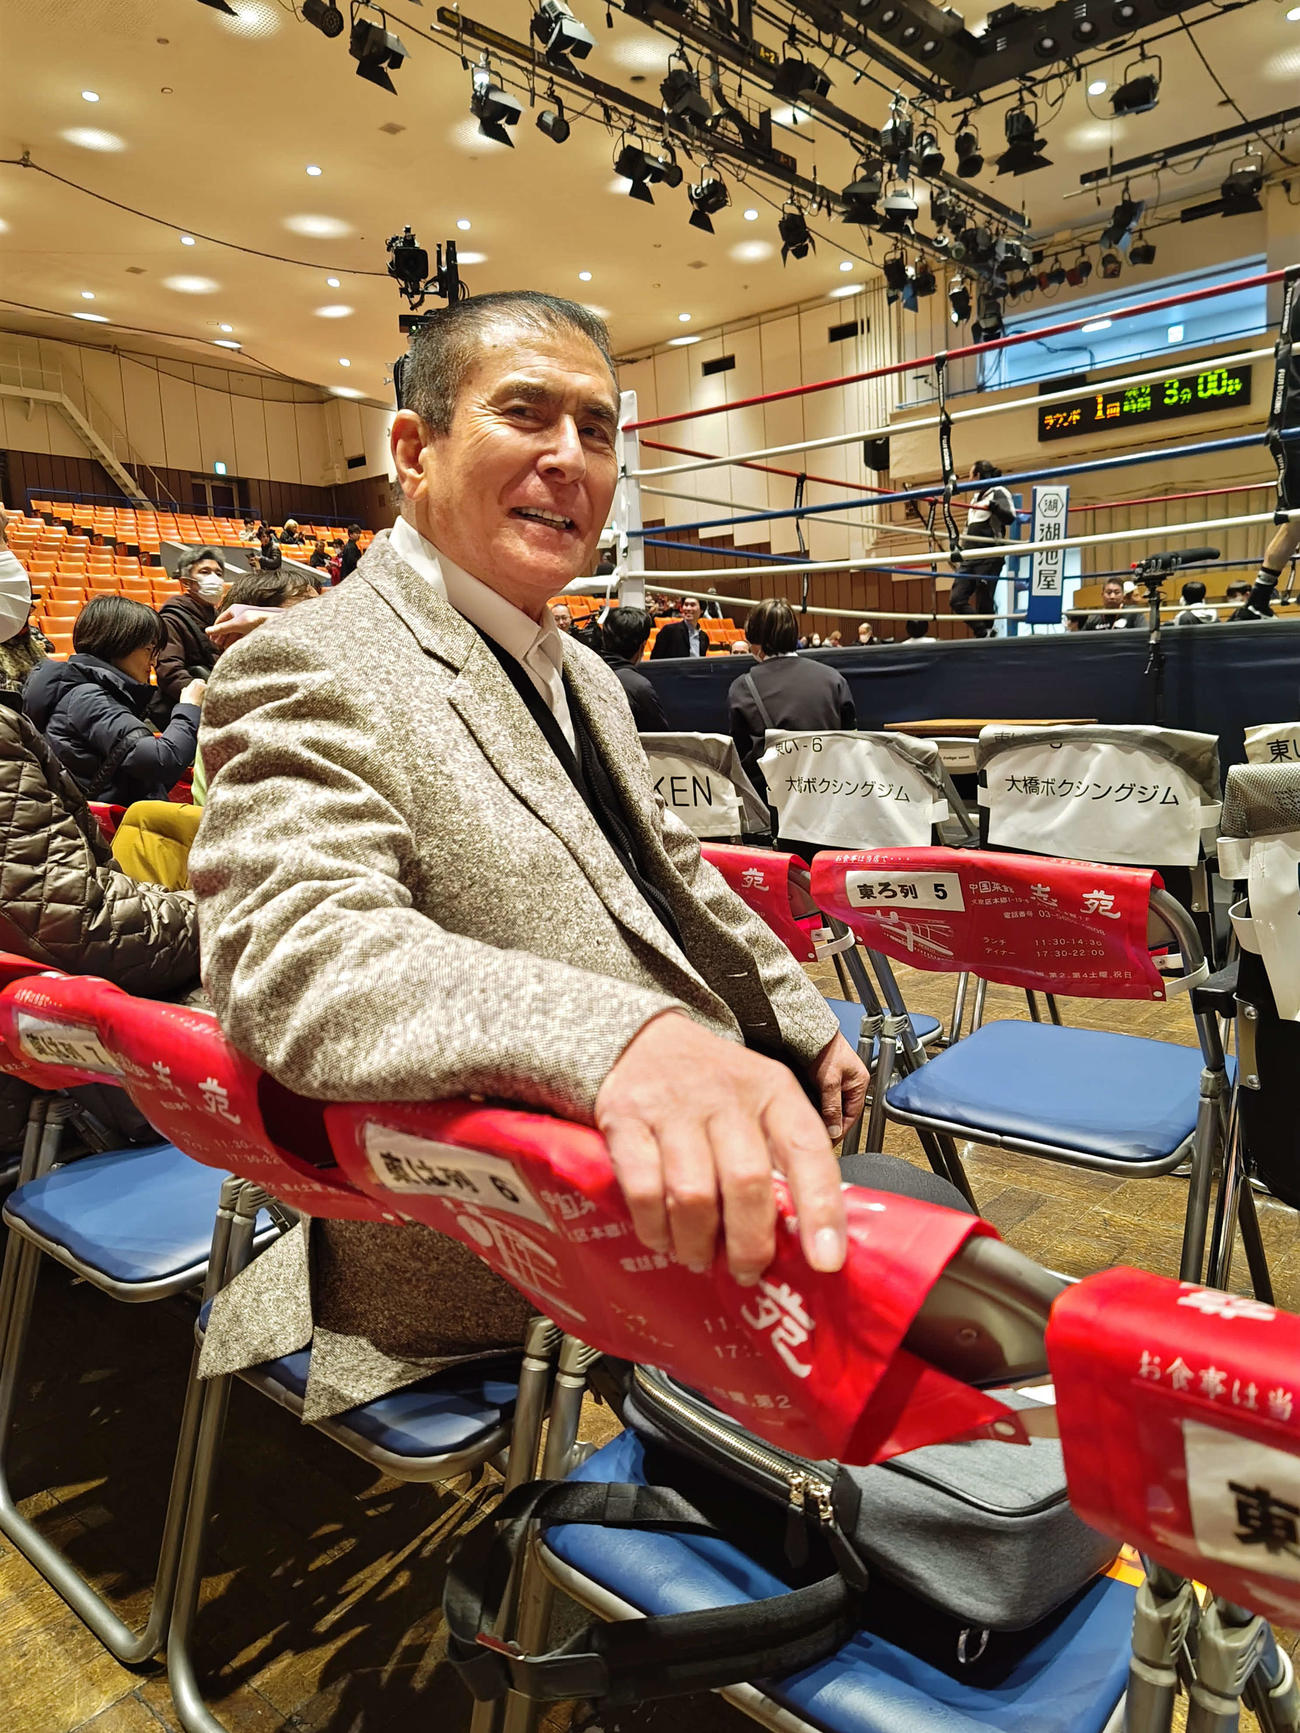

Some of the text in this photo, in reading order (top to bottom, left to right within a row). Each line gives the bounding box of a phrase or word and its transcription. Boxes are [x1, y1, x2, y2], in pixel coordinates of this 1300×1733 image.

[1037, 522, 1060, 590] 湖池屋
[1005, 775, 1180, 806] 大橋ボクシングジム
[741, 867, 770, 892] 苑
[857, 881, 948, 900] 東ろ列 5
[1080, 889, 1121, 919] 苑
[489, 1174, 519, 1203] 6
[740, 1280, 816, 1378] 苑
[1226, 1480, 1300, 1556] 東
